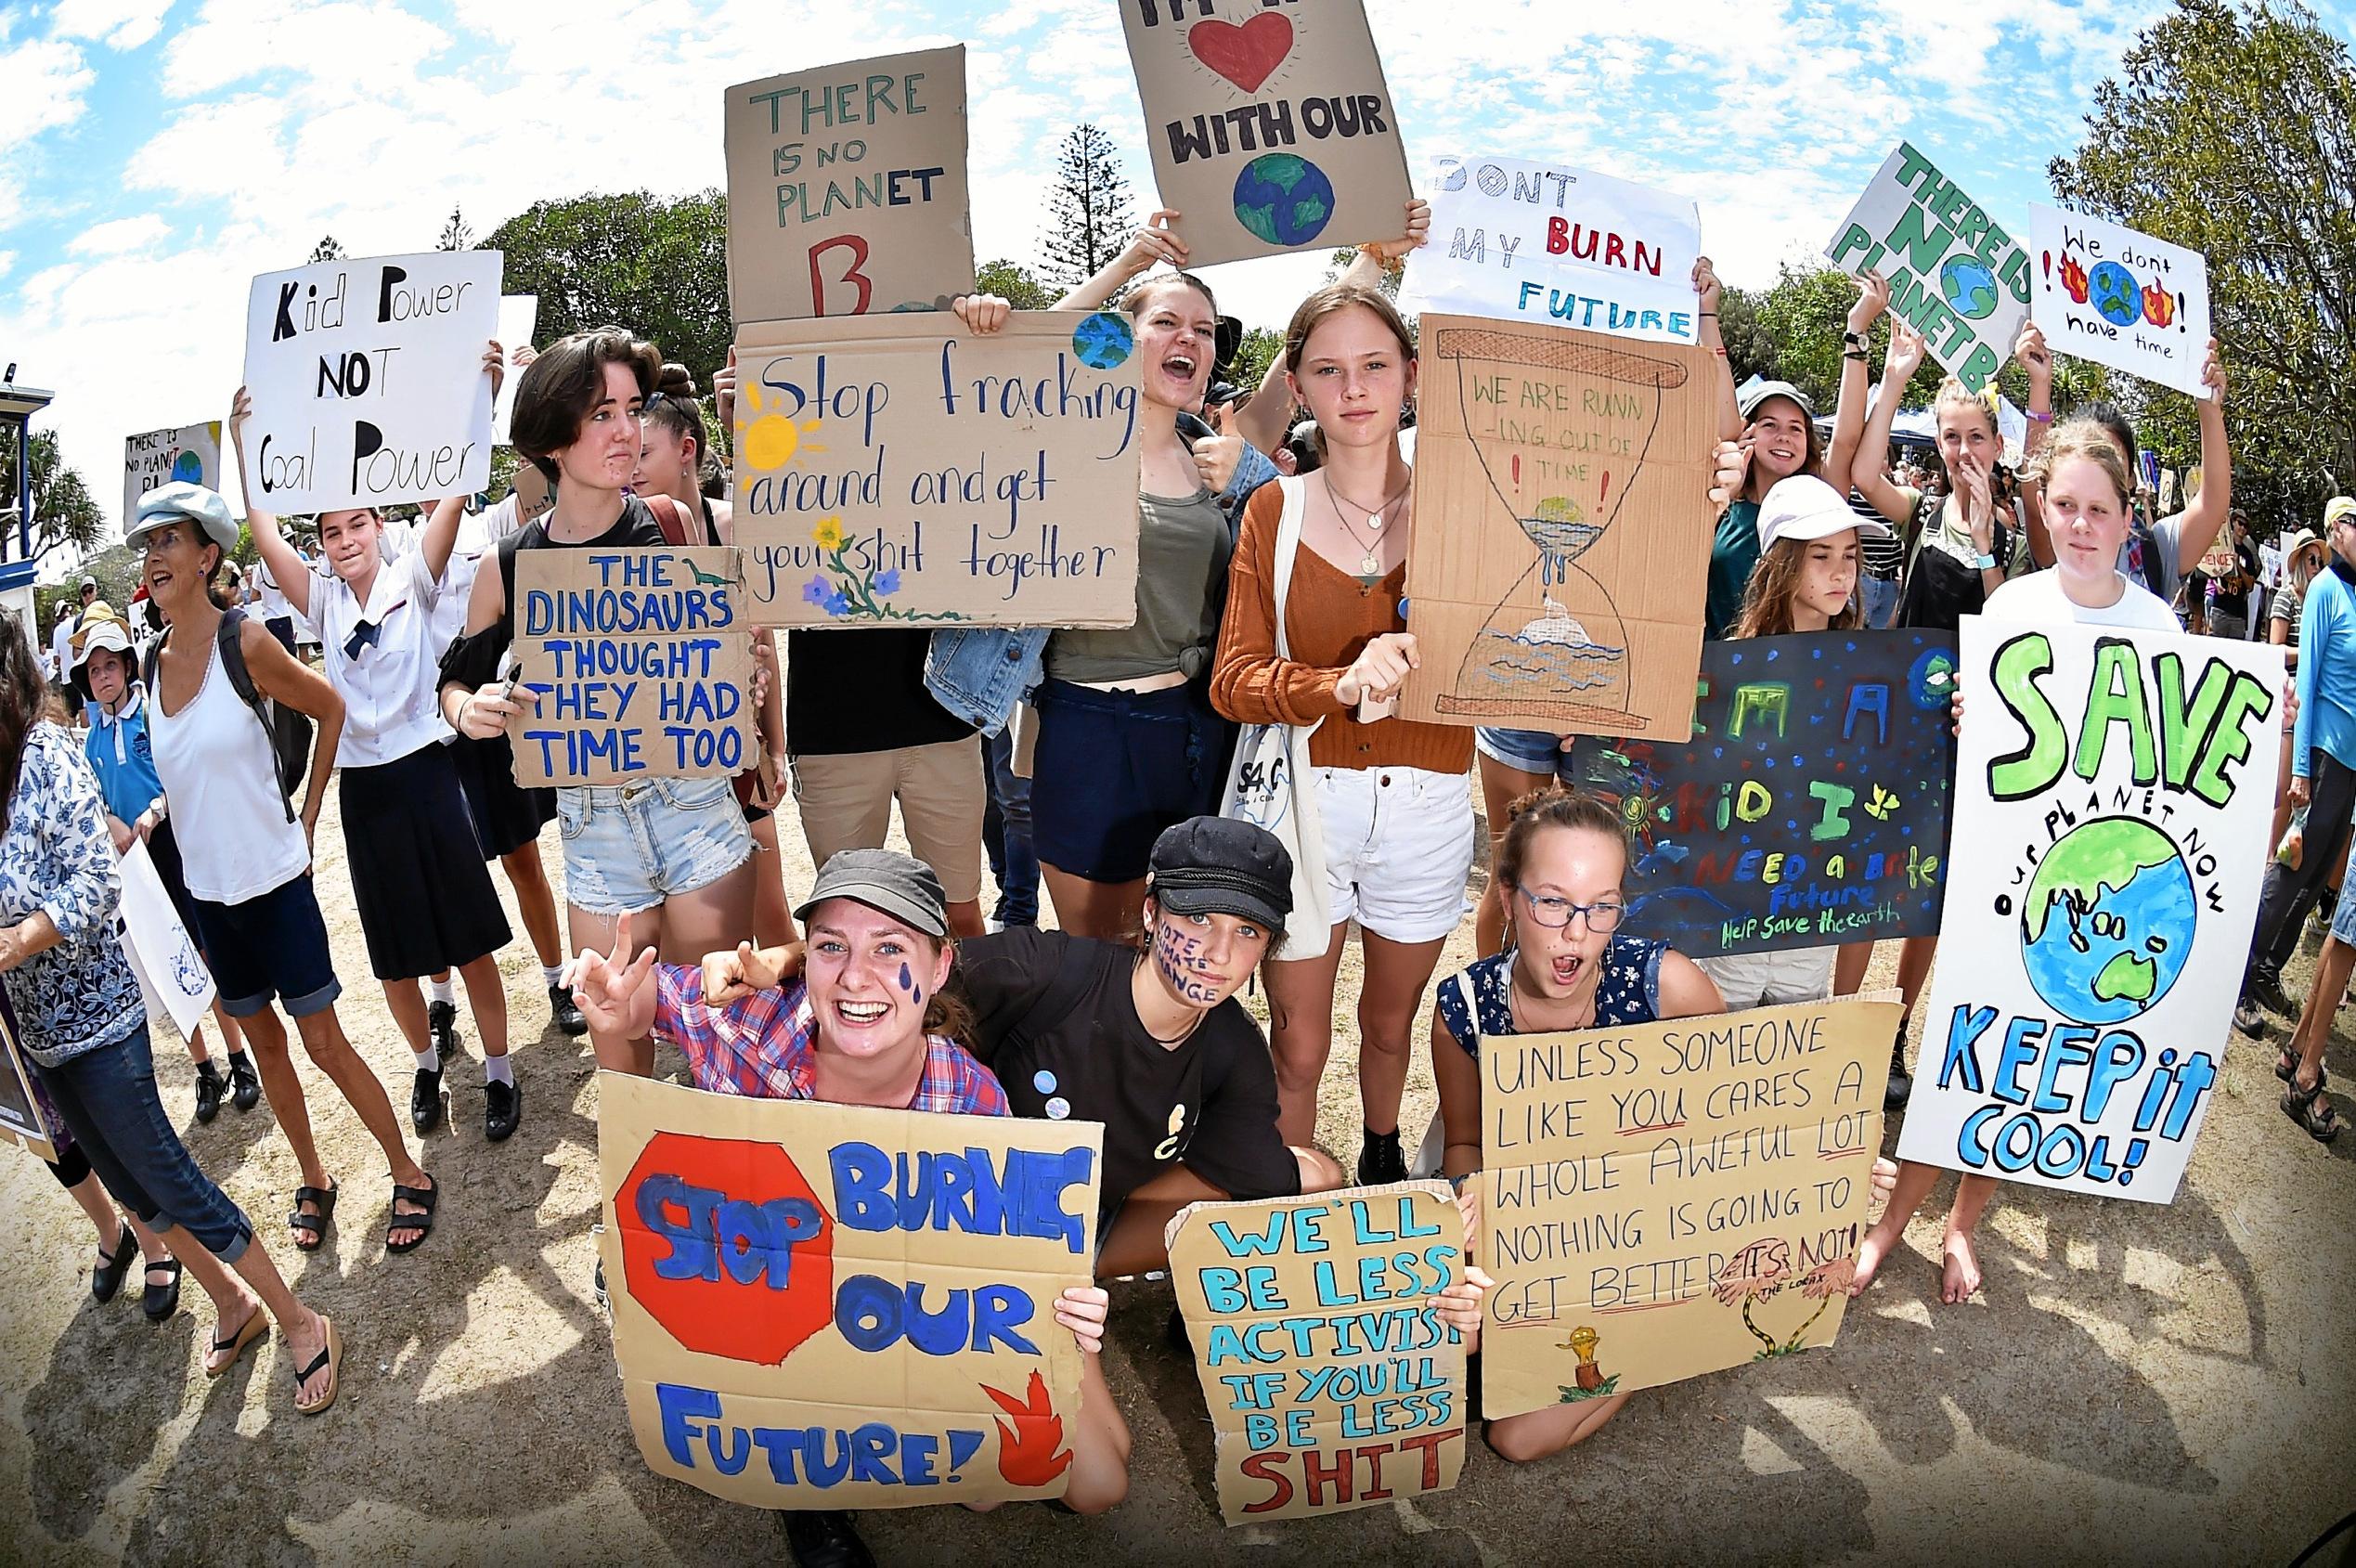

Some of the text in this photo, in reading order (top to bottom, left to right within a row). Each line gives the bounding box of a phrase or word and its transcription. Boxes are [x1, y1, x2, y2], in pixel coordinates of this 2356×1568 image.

[749, 73, 927, 135] THERE
[1166, 95, 1387, 164] WITH OUR
[773, 140, 867, 177] IS NO
[777, 167, 945, 227] PLANET
[1895, 141, 2031, 304] THERE IS
[1449, 215, 1662, 277] MY BURN
[2064, 225, 2103, 258] We
[273, 266, 472, 342] Kid Power
[1519, 280, 1690, 338] FUTURE
[1832, 223, 1998, 395] PLANET B
[2065, 312, 2173, 359] have time
[317, 347, 402, 398] NOT
[761, 339, 1137, 460] Stop fracking
[1474, 375, 1643, 420] WE ARE RUNN
[126, 429, 178, 453] THERE IS
[126, 447, 179, 473] NO PLANET
[260, 421, 475, 495] Coal Power
[1536, 460, 1590, 482] TIME
[1560, 429, 1602, 452] OUT
[1609, 436, 1632, 456] OF
[749, 445, 1057, 539] around and get
[589, 555, 675, 587] THE
[855, 521, 925, 573] shit
[960, 524, 1116, 601] together
[526, 589, 733, 635] DINOSAURS
[543, 639, 721, 679] THOUGHT
[523, 680, 741, 723] THEY HAD
[1987, 631, 2274, 809] SAVE
[524, 726, 742, 777] TIME TOO
[1808, 780, 1855, 841] I
[1694, 848, 1806, 887] NEED
[1826, 854, 1845, 879] a
[2182, 827, 2226, 914] NOW
[1769, 883, 1877, 915] Future
[1845, 901, 1900, 927] earth
[1494, 1016, 1827, 1095] UNLESS SOMEONE
[1936, 1004, 2217, 1142] KEEP it
[1497, 1060, 1863, 1149] LIKE YOU CARES A
[1496, 1109, 1871, 1210] WHOLE AWEFUL LOT
[1959, 1104, 2149, 1186] COOL!
[635, 1173, 823, 1289] STOP
[1209, 1197, 1441, 1258] WE'LL
[1495, 1176, 1851, 1270] NOTHING IS GOING TO
[1199, 1245, 1458, 1314] BE LESS
[1492, 1276, 1567, 1324] GET
[1590, 1253, 1724, 1309] BETTER
[1798, 1222, 1858, 1272] NOT!
[1760, 1273, 1827, 1296] THE LORAX
[835, 1274, 1042, 1357] OUR
[1220, 1357, 1452, 1410] IF YOU'LL
[655, 1382, 985, 1489] FUTURE!
[1244, 1391, 1453, 1451] BE LESS
[1240, 1428, 1464, 1514] SHIT
